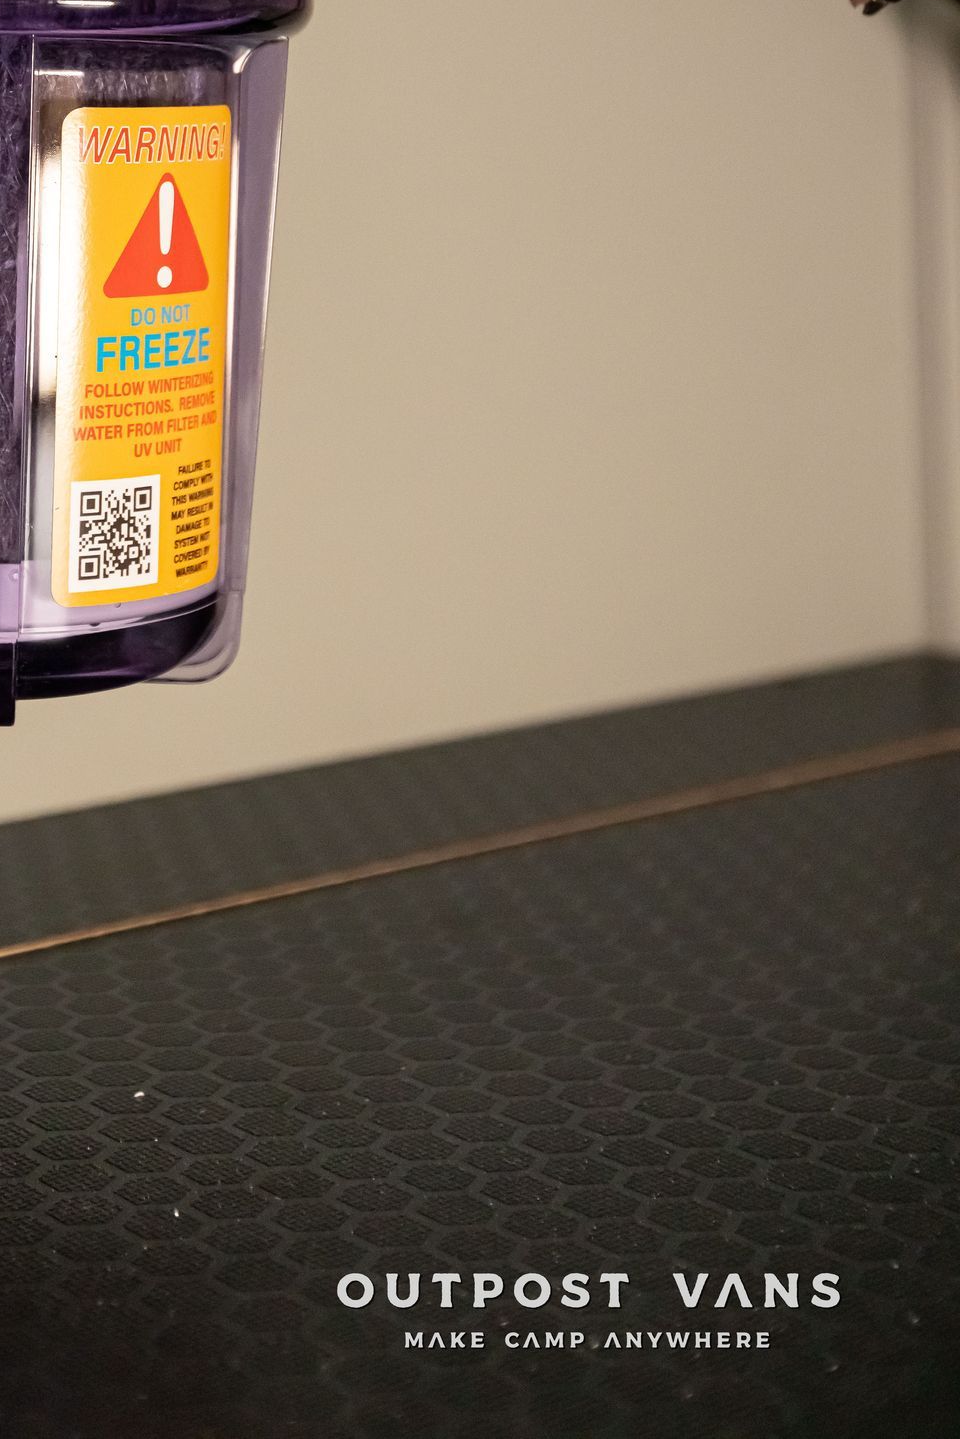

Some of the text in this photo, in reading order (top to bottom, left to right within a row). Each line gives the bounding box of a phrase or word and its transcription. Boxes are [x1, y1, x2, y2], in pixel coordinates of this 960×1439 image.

[78, 122, 227, 164] WARNING!
[130, 304, 191, 326] DO NOT
[96, 327, 210, 372] FREEZE
[85, 371, 214, 399] FOLLOW WINTERIZING
[79, 391, 215, 420] INSTUCTIONS. REMOVE
[72, 410, 217, 442] WATER FROM FILTER AND
[134, 438, 183, 458] UV UNIT
[178, 462, 203, 475] FAILURE
[173, 477, 199, 491] COMPLY
[172, 494, 187, 506] THIS
[171, 509, 186, 520] MAY
[176, 519, 201, 534] DAMAGE
[174, 535, 198, 549] SYSTEM
[174, 548, 202, 564] COVERED
